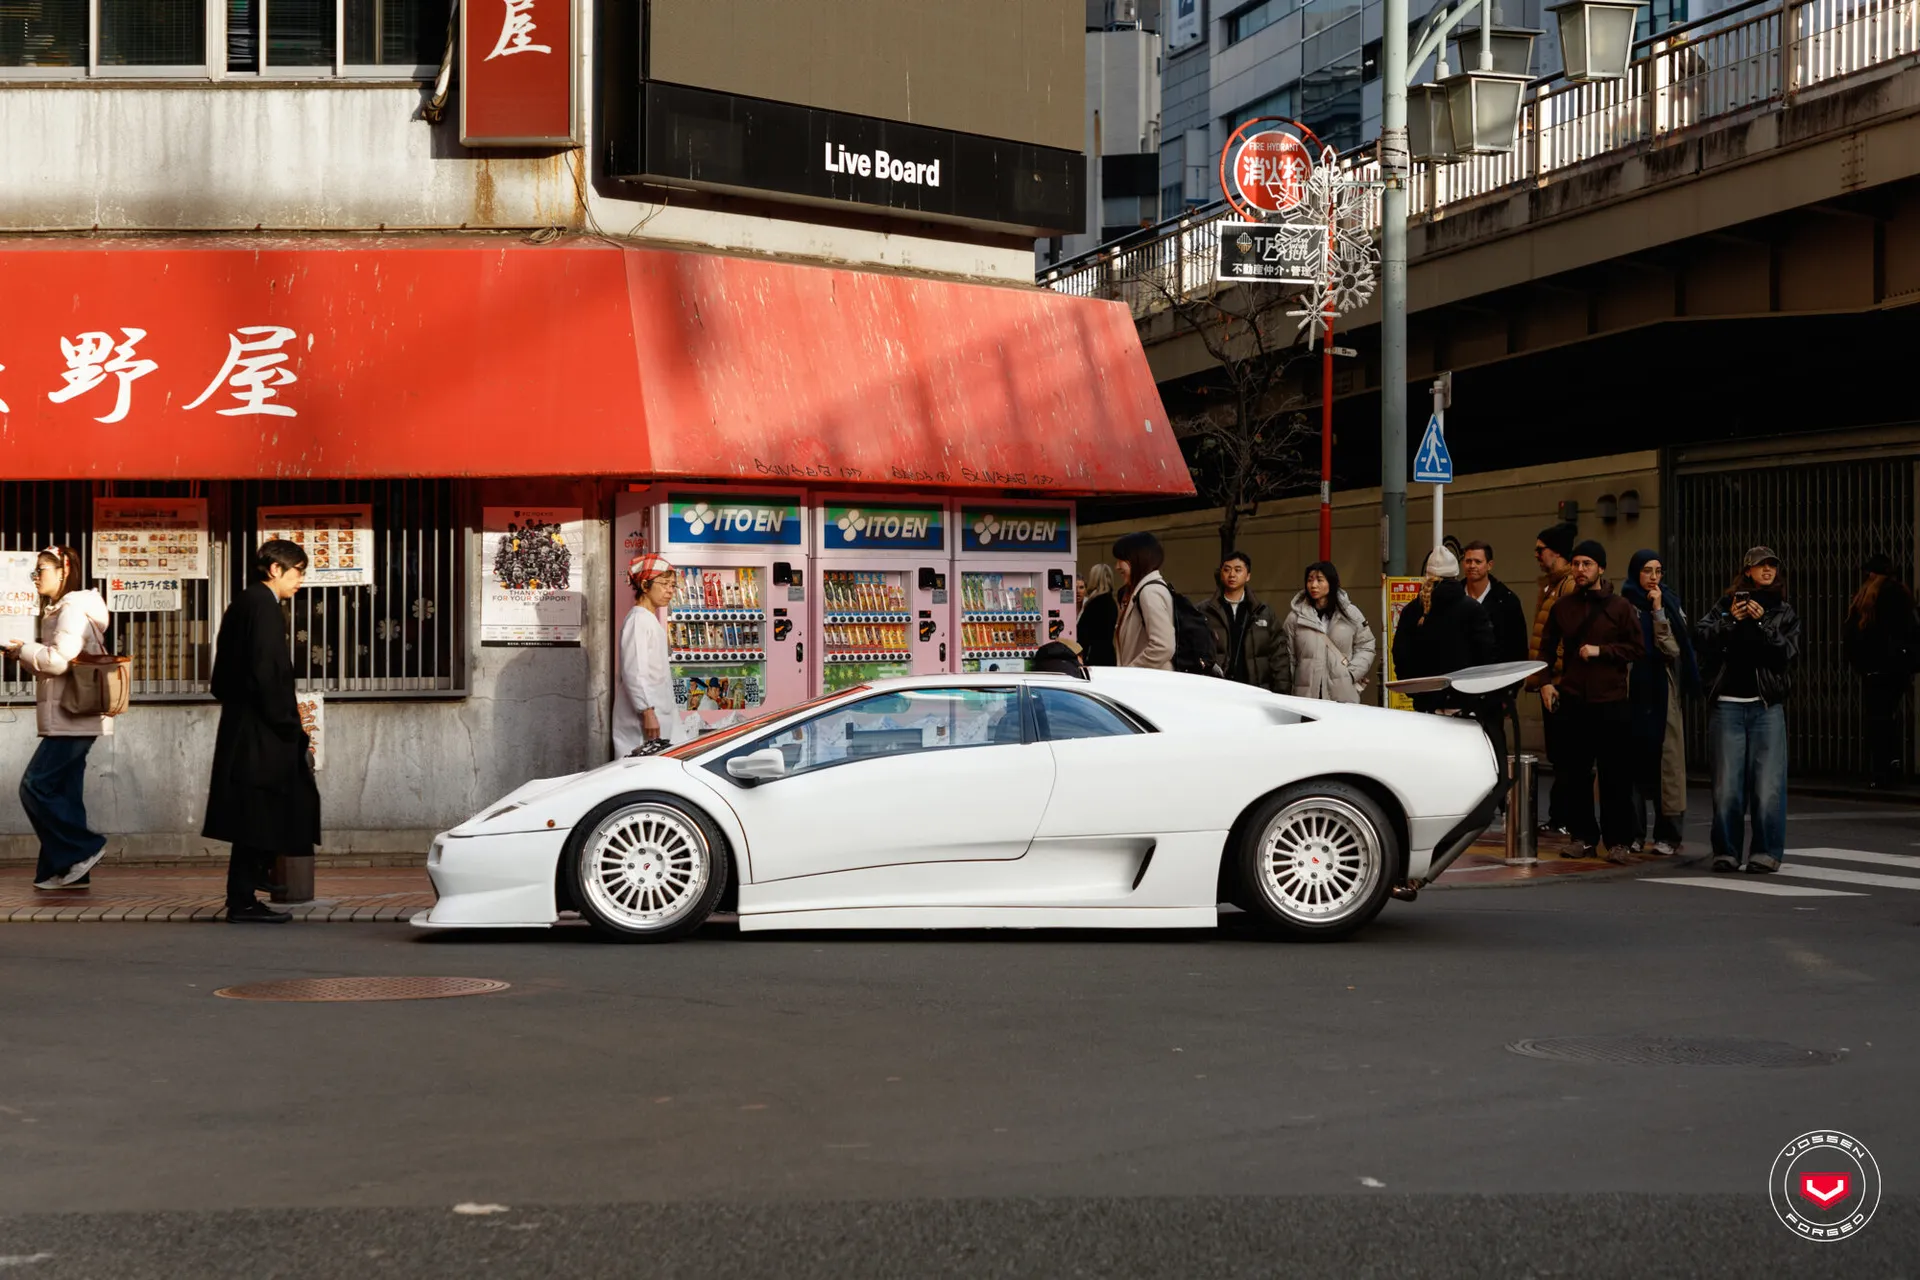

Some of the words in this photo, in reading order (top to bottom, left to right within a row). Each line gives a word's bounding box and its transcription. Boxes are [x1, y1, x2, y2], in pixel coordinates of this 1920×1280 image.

[1249, 142, 1265, 151] FIRE
[1267, 142, 1299, 152] HYDRANT
[825, 142, 872, 177] Live
[875, 149, 940, 187] Board
[1243, 156, 1306, 186] 消火栓
[0, 326, 298, 424] 野屋
[714, 509, 753, 532] ITO
[754, 510, 784, 532] EN
[865, 516, 900, 538] ITO
[901, 517, 928, 538] EN
[999, 520, 1031, 541] ITO
[1032, 521, 1057, 541] EN
